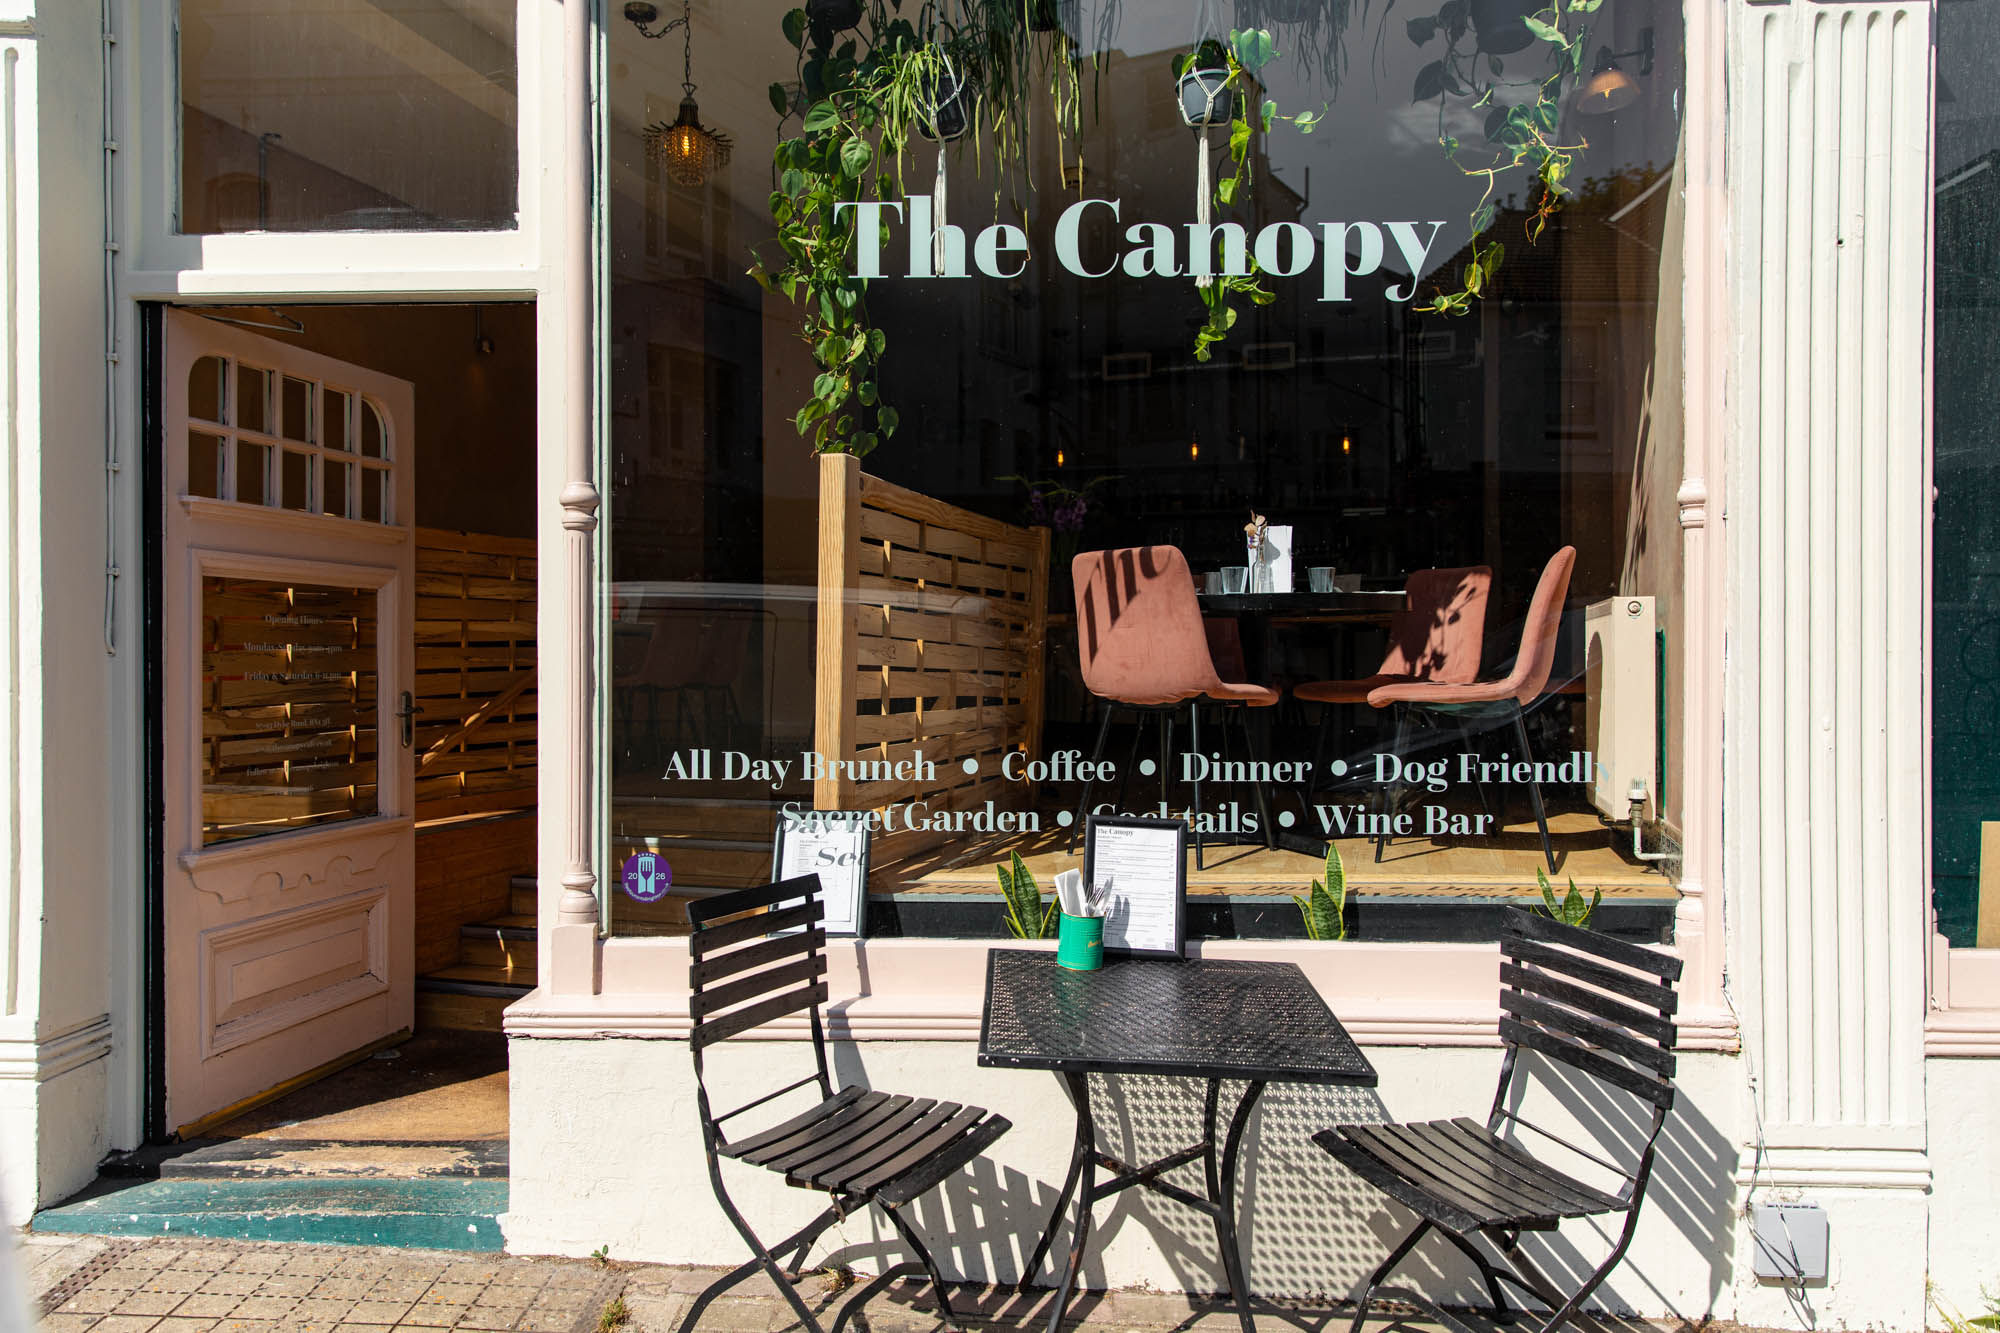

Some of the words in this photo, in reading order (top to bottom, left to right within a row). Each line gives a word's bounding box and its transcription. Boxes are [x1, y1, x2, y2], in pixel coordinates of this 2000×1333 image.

[833, 194, 1029, 279] The
[1054, 197, 1447, 302] Canopy
[662, 748, 712, 781] All
[721, 751, 792, 790] Day
[800, 749, 937, 782] Brunch
[1001, 749, 1116, 783] Coffee
[1180, 752, 1313, 783] Dinner
[1372, 752, 1448, 793] Dog
[781, 800, 899, 833] Secret
[903, 800, 1041, 834] Garden
[1313, 803, 1412, 835] Wine
[1422, 805, 1494, 836] Bar
[627, 872, 638, 880] 20
